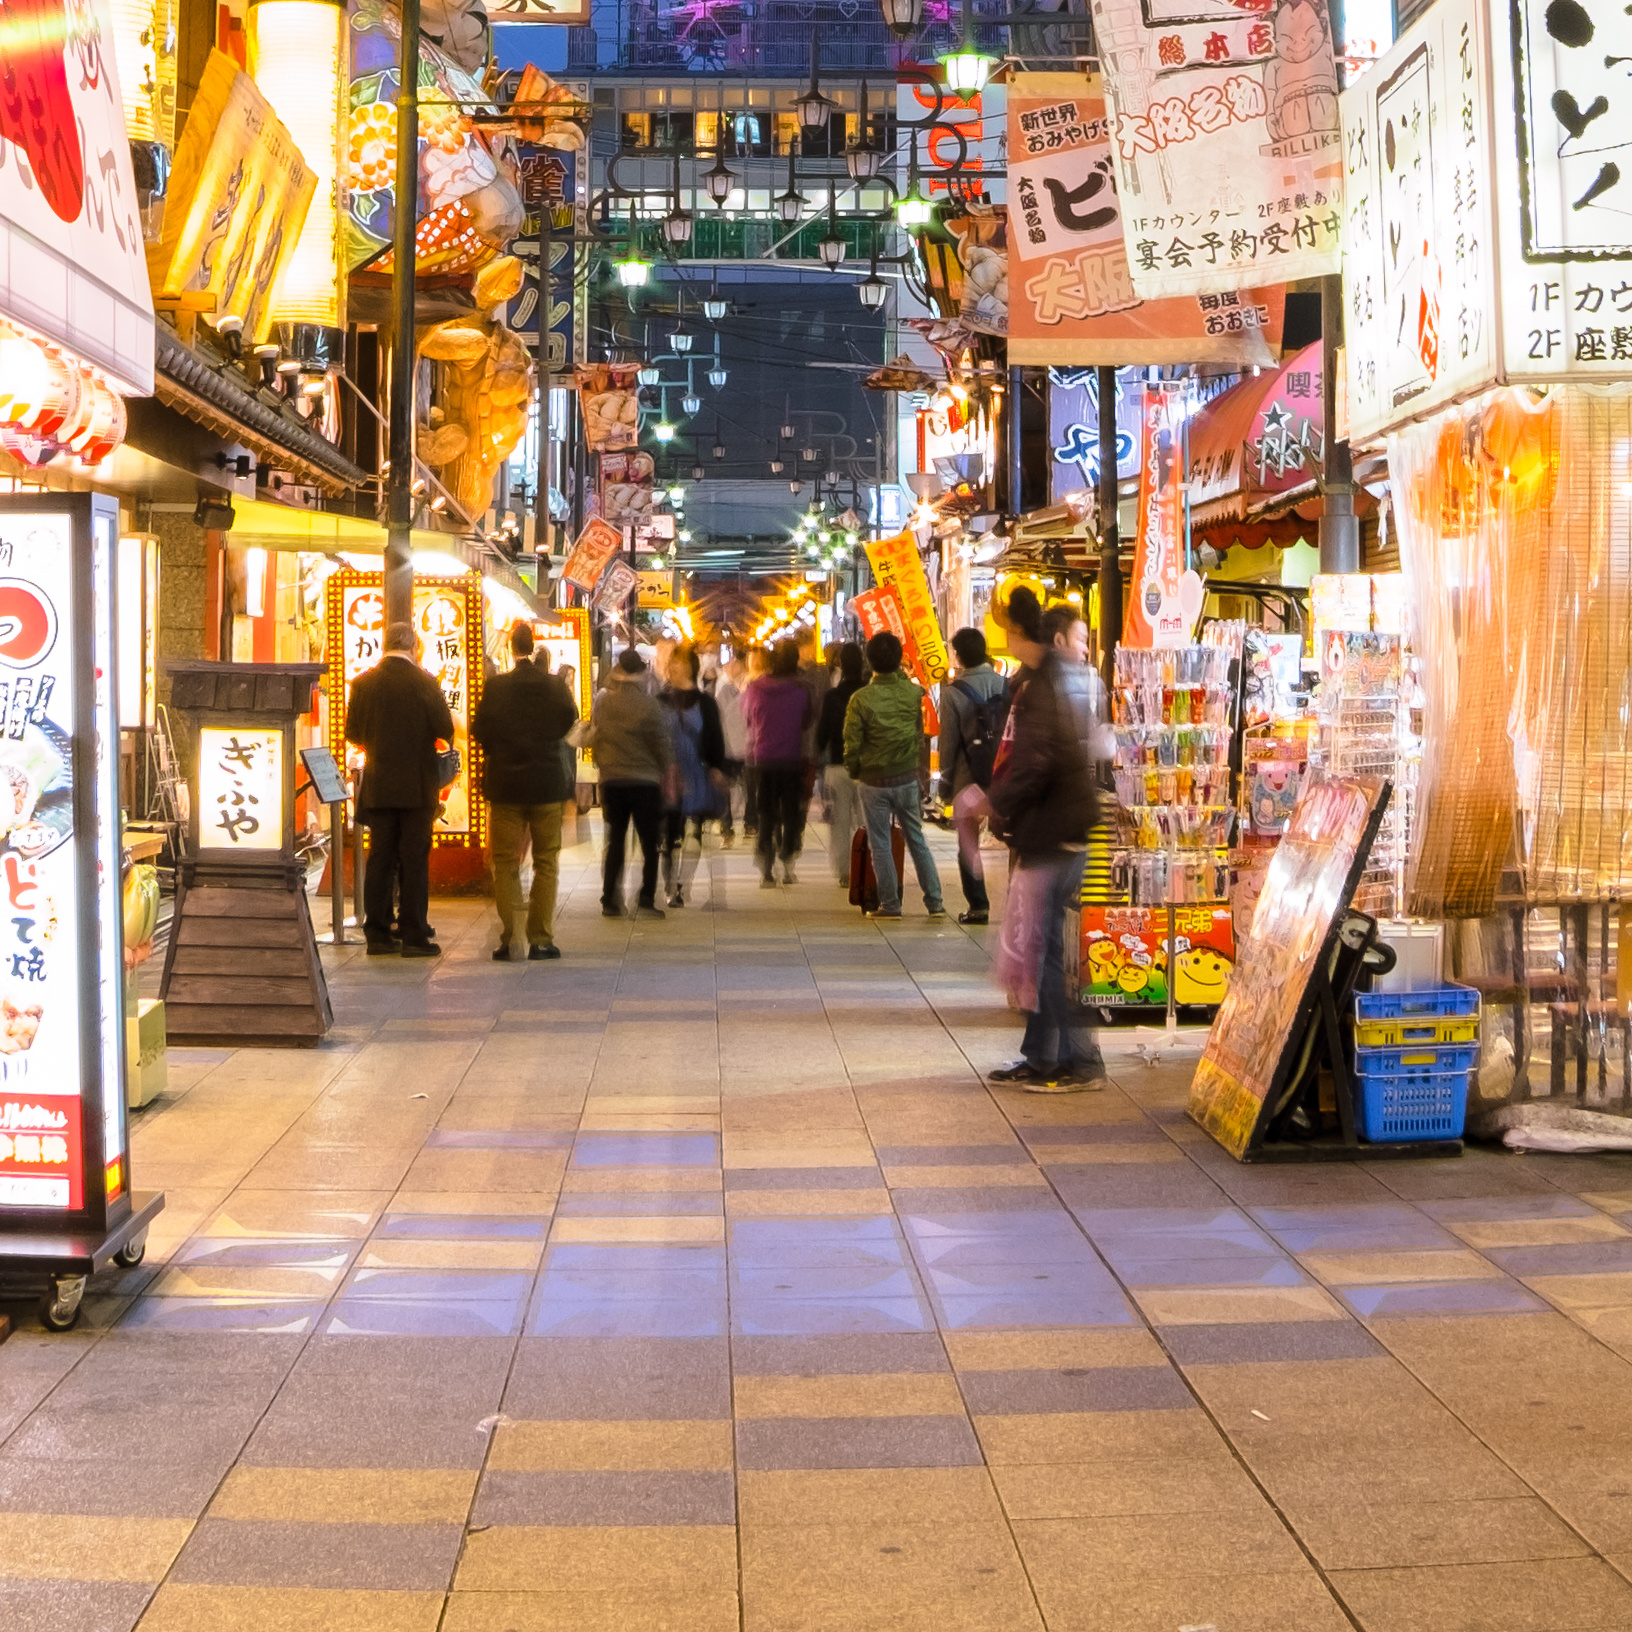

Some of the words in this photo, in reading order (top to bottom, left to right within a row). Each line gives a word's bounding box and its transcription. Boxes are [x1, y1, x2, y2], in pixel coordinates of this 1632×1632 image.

[1159, 23, 1273, 66] 総本店
[1118, 74, 1265, 158] 大阪名物
[1459, 21, 1475, 149] 元祖
[1021, 103, 1078, 133] 新世界
[1016, 175, 1046, 244] 大阪名物
[1134, 212, 1343, 270] 宴会予約受付中
[1528, 282, 1560, 312] 1F
[1527, 328, 1562, 360] 2F
[216, 735, 262, 843] ぎふや
[5, 856, 49, 983] どて焼
